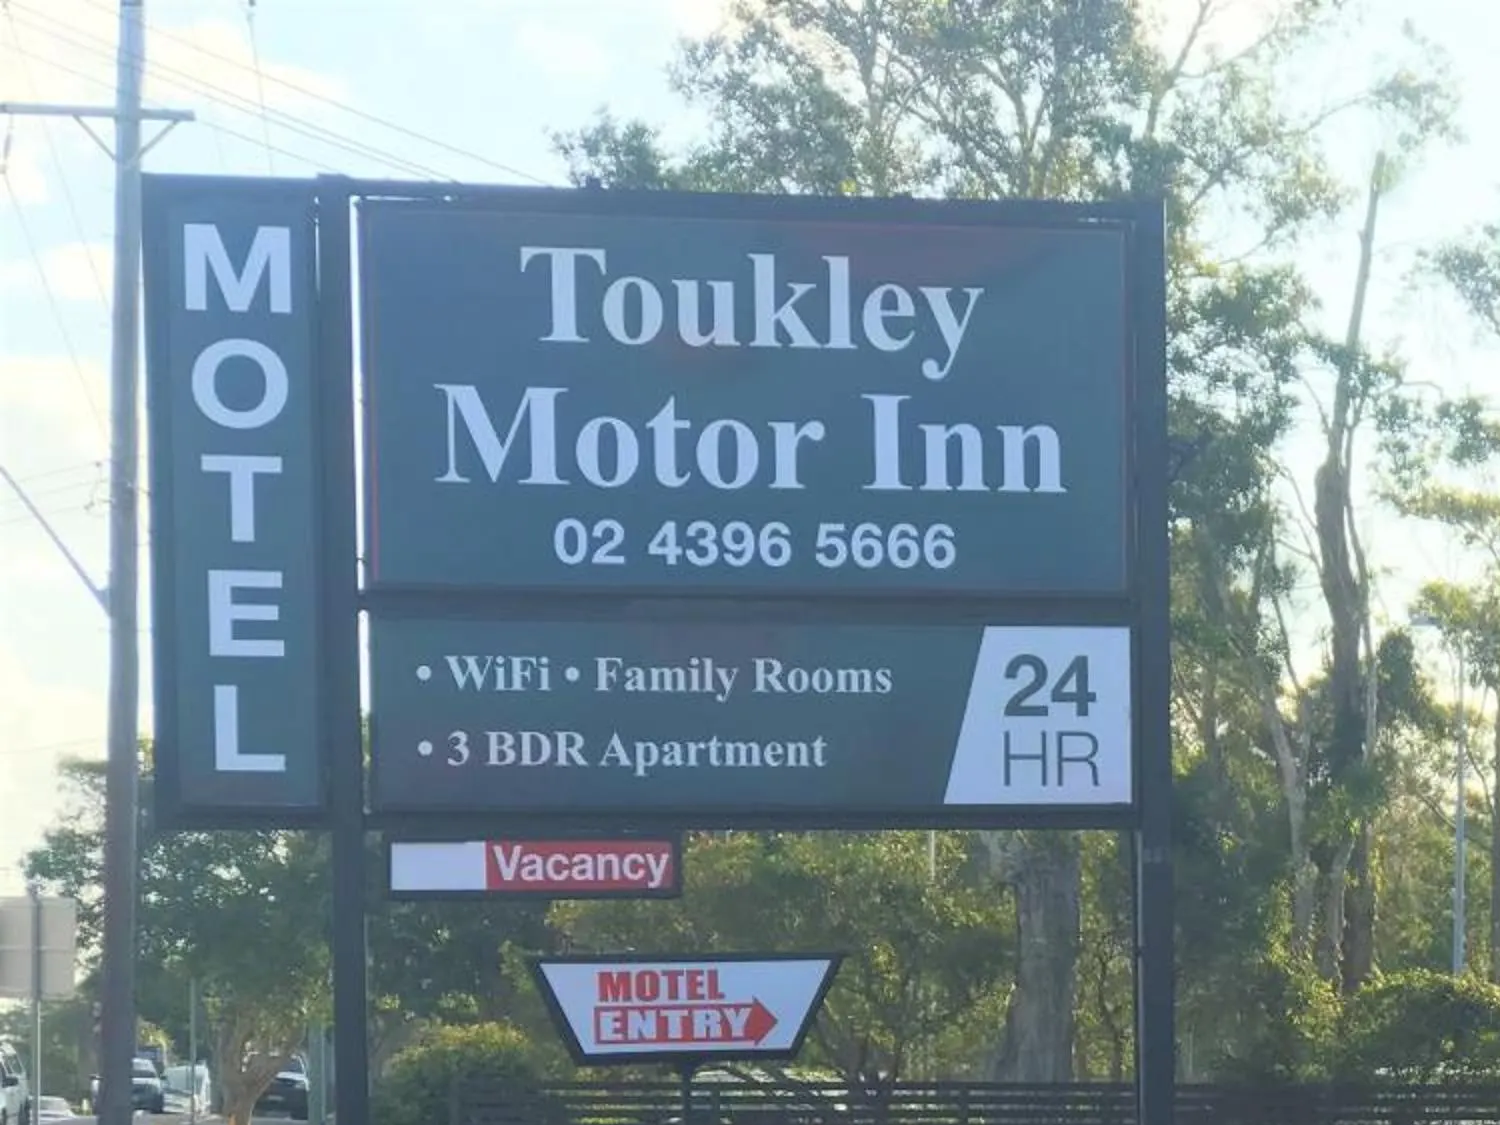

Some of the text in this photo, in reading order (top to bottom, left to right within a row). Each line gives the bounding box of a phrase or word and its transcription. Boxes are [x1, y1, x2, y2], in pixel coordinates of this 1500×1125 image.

[519, 245, 985, 380] Toukley
[433, 383, 1068, 493] Motor Inn
[183, 223, 293, 773] MOTEL
[553, 518, 957, 569] 02 4396 5666
[446, 655, 893, 702] WiFi Family Rooms
[1003, 653, 1098, 718] 24
[446, 731, 828, 777] 3 BDR Apartment
[1003, 730, 1101, 788] HR
[492, 844, 669, 889] Vacancy
[599, 968, 725, 1003] MOTEL
[599, 1006, 753, 1042] ENTRY
